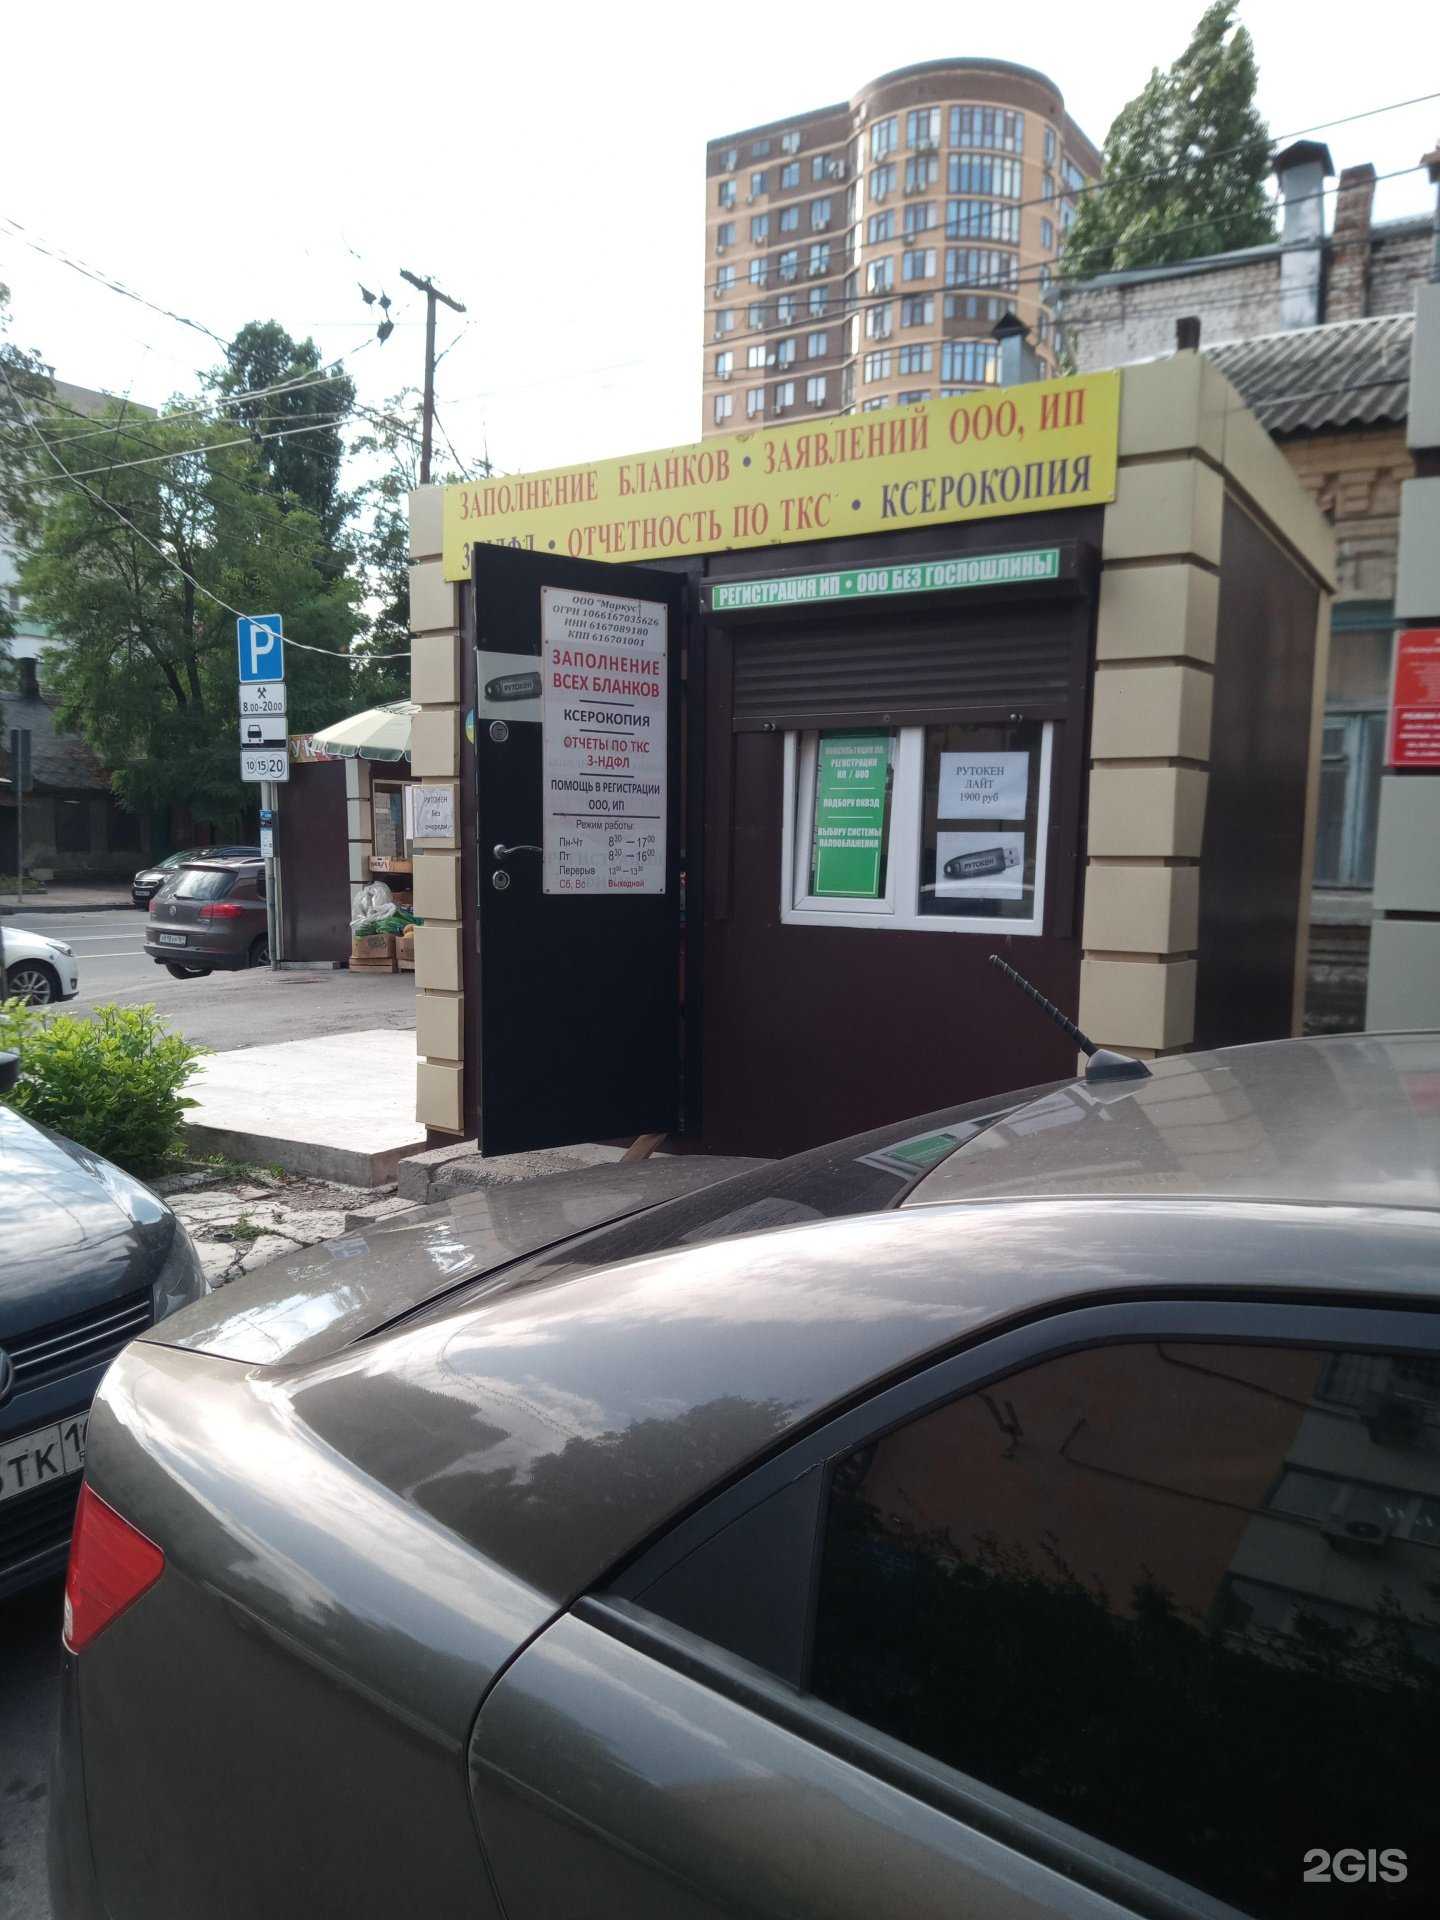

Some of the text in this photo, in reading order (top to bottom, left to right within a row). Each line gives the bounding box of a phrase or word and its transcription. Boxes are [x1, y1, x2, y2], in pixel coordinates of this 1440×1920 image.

[460, 388, 1088, 521] ЗАПОЛНЕНИЕ БЛАНКОВ ЗАЯВЛЕНИЙ ООО, ИП
[567, 510, 722, 558] ОТЧЕТНОСТЬ
[733, 503, 769, 538] ПО
[780, 493, 832, 532] ТКС
[881, 455, 1092, 519] КСЕРОКОПИЯ
[719, 554, 1053, 606] РЕГИСТРАЦИЯ ИП ООО БЕЗ ГОСПОШЛИНЫ
[572, 596, 595, 606] ООО
[553, 605, 580, 616] ОГРН
[564, 618, 587, 629] ИНН
[568, 630, 590, 640] КПП
[552, 649, 660, 676] ЗАПОЛНЕНИЕ
[553, 672, 660, 698] ВСЕХ БЛАНКОВ
[563, 709, 650, 727] КСЕРОКОПИЯ
[563, 736, 650, 753] ОТЧЕТЫ ПО ТКС
[246, 760, 283, 772] 10 15 20
[587, 755, 630, 769] 3-НДФЛ
[956, 766, 1005, 776] РУТОКЕН
[551, 779, 660, 796] ПОМОЩЬ В РЕГИСТРАЦИИ
[964, 778, 995, 789] ЛАЙТ
[960, 792, 999, 804] 1900 руб
[612, 801, 625, 811] ИП
[576, 819, 633, 831] Режим работы
[559, 851, 570, 861] Пт
[559, 865, 596, 877] Перерыв
[608, 879, 645, 889] Выходной
